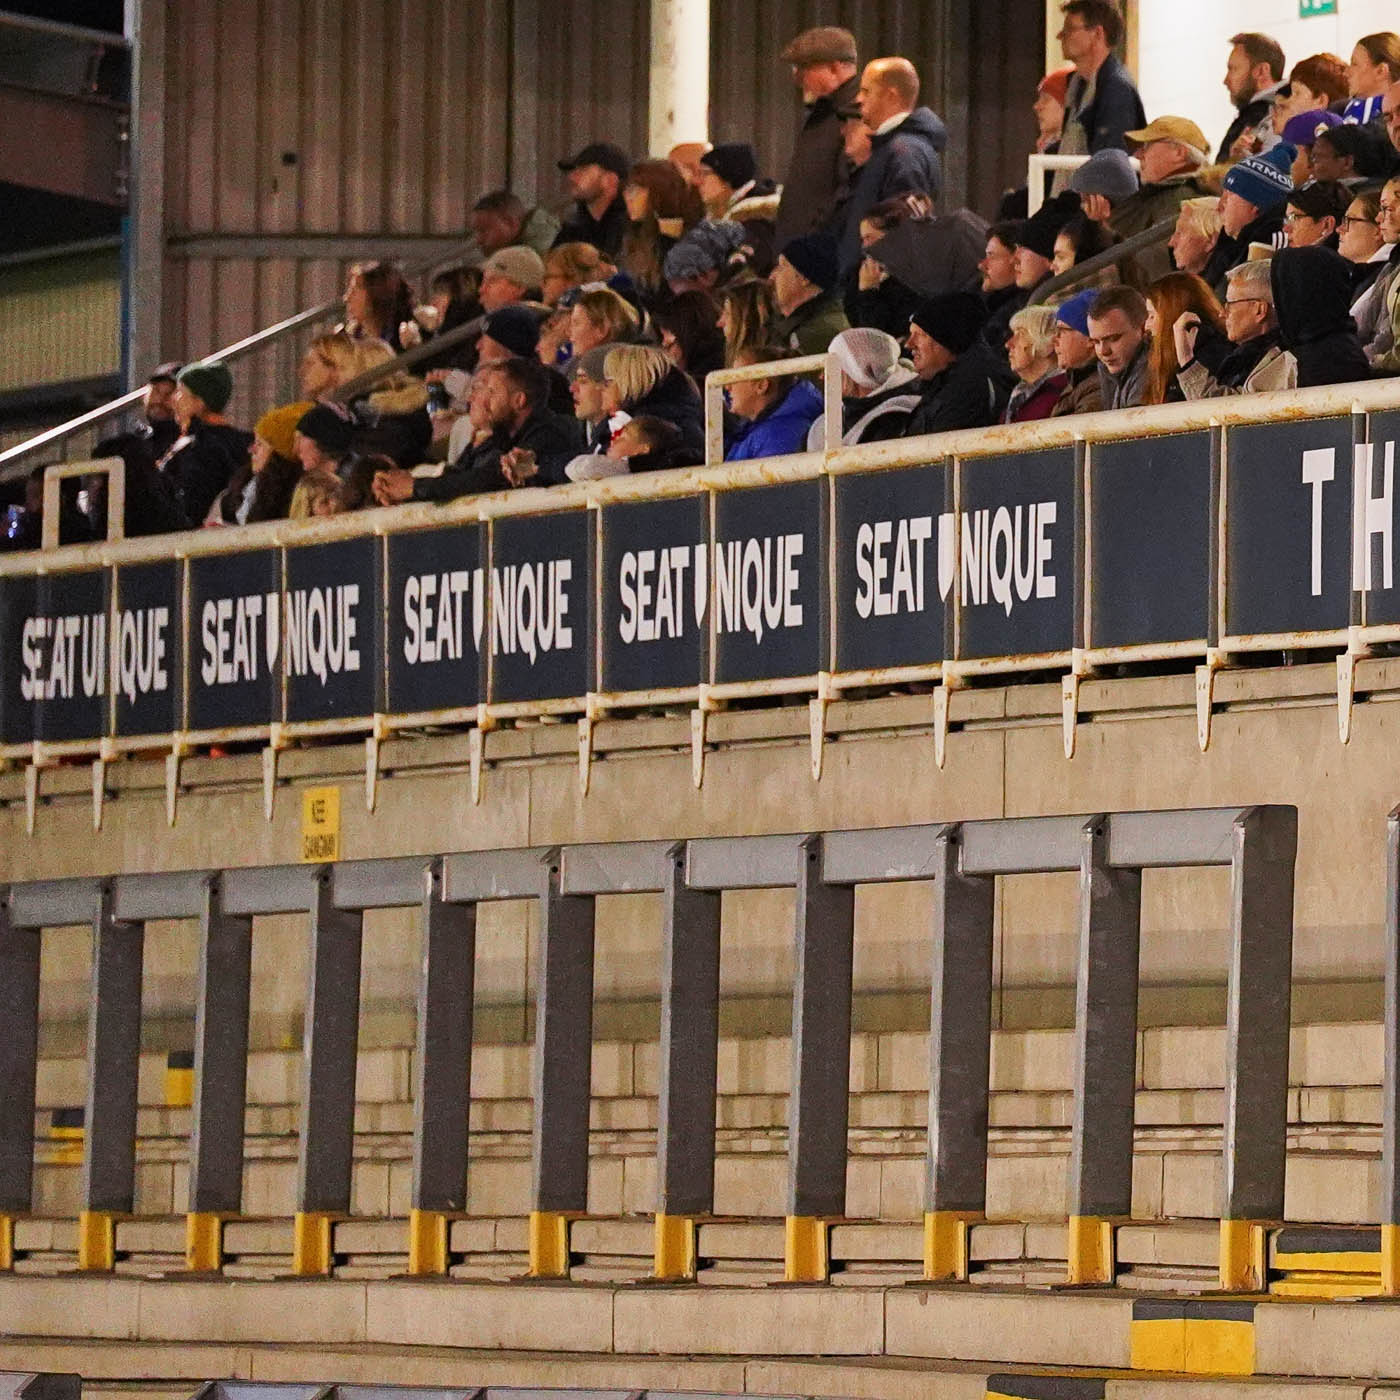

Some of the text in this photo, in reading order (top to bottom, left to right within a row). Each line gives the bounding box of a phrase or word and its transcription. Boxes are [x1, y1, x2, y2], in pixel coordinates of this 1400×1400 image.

[403, 559, 573, 666] SEAT UNIQUE
[619, 533, 804, 646] SEAT UNIQUE
[855, 501, 1057, 620] SEAT UNIQUE
[20, 614, 81, 701] SEAT
[201, 583, 361, 688] SEAT UNIQUE
